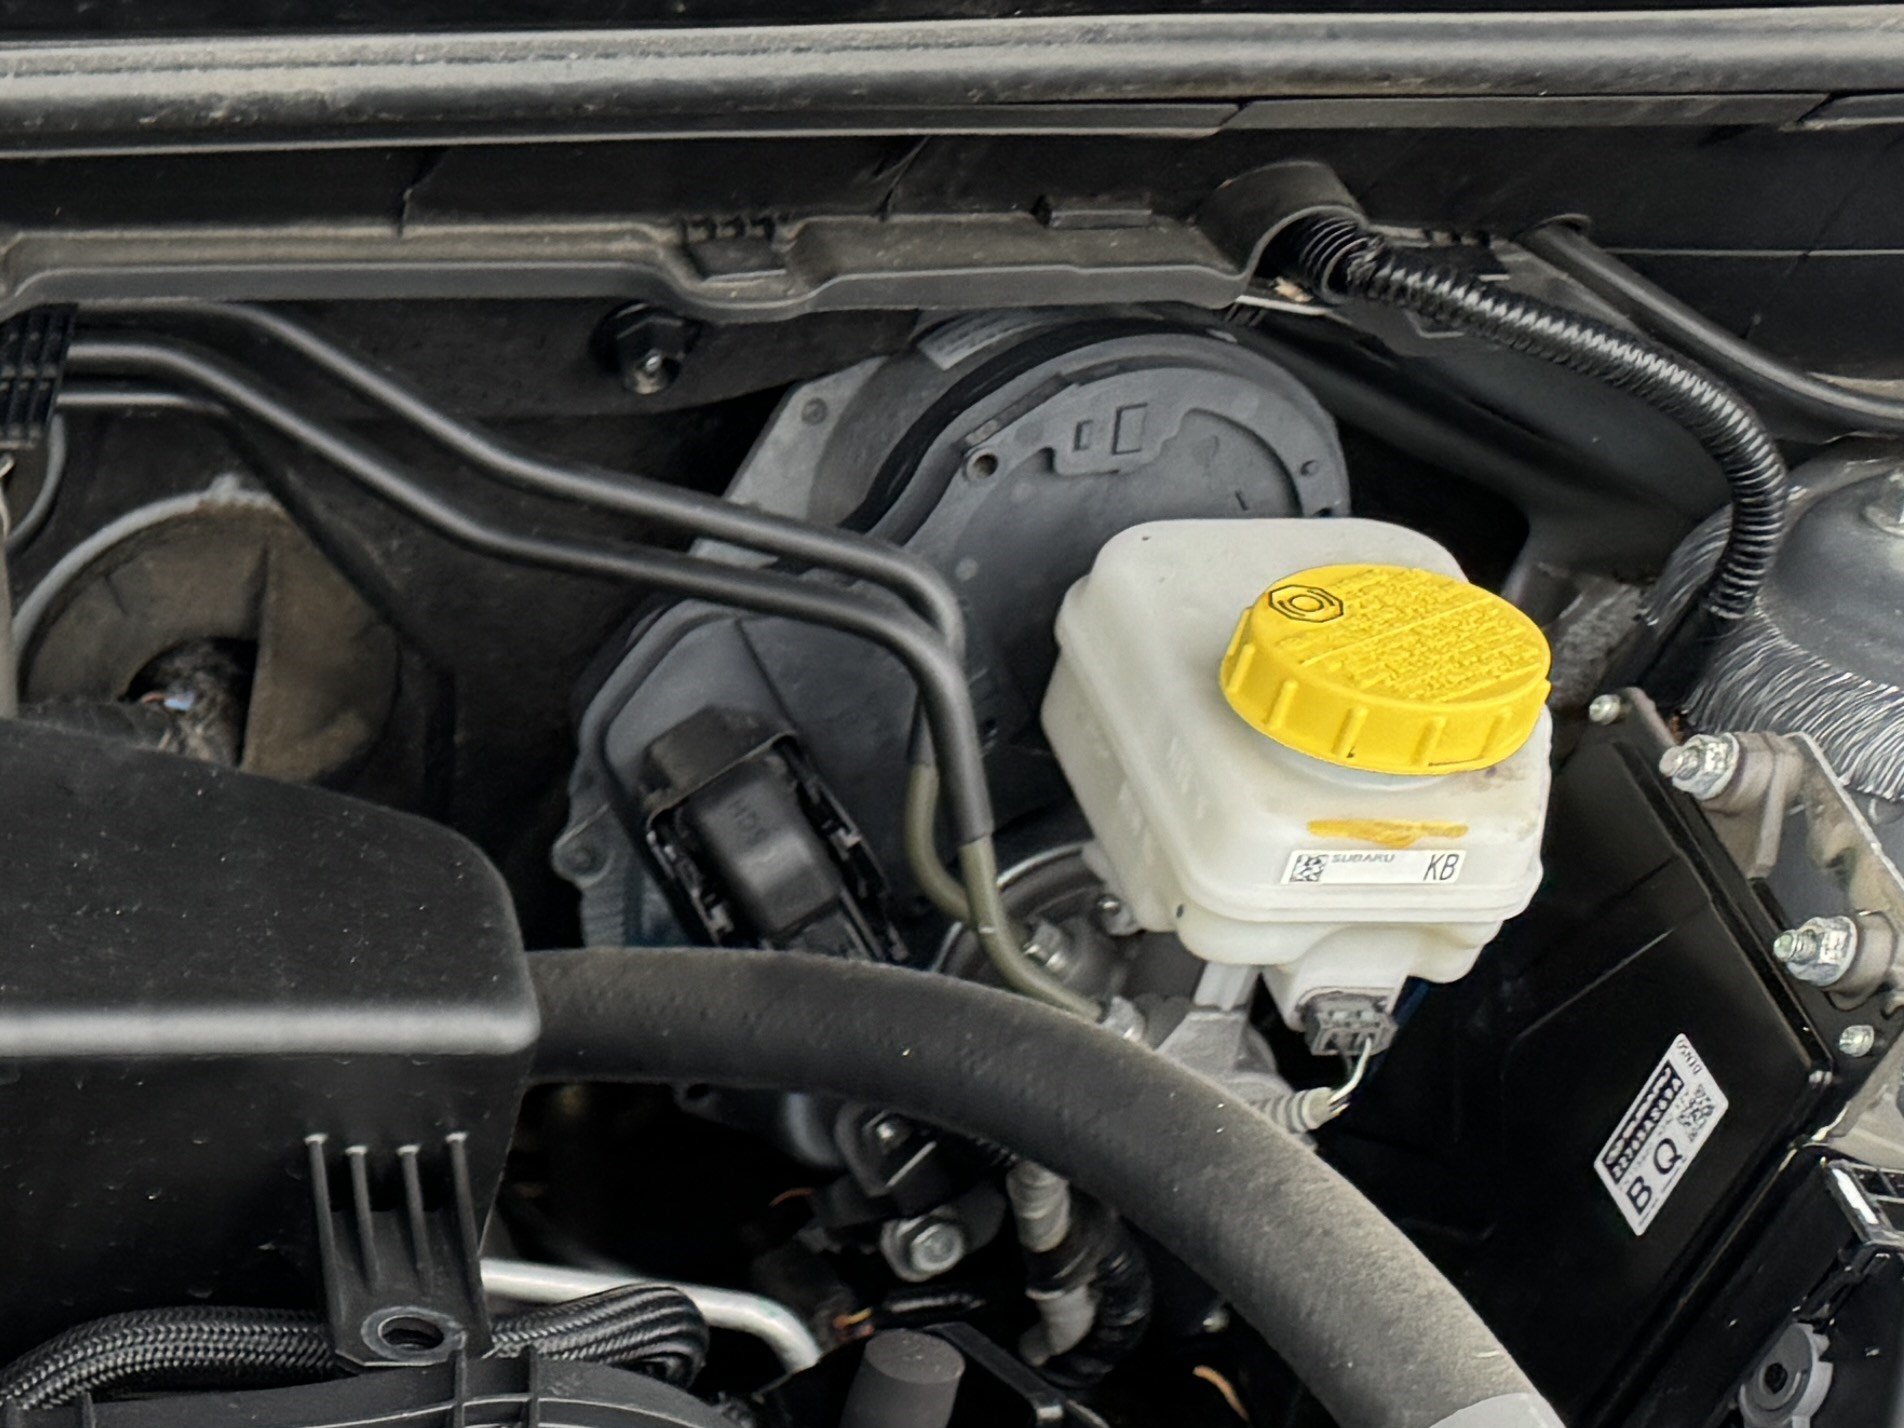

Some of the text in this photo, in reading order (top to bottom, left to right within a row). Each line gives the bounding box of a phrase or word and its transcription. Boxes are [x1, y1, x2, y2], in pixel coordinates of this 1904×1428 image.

[1332, 854, 1460, 881] SUBARU KB
[1626, 1137, 1683, 1216] B Q
